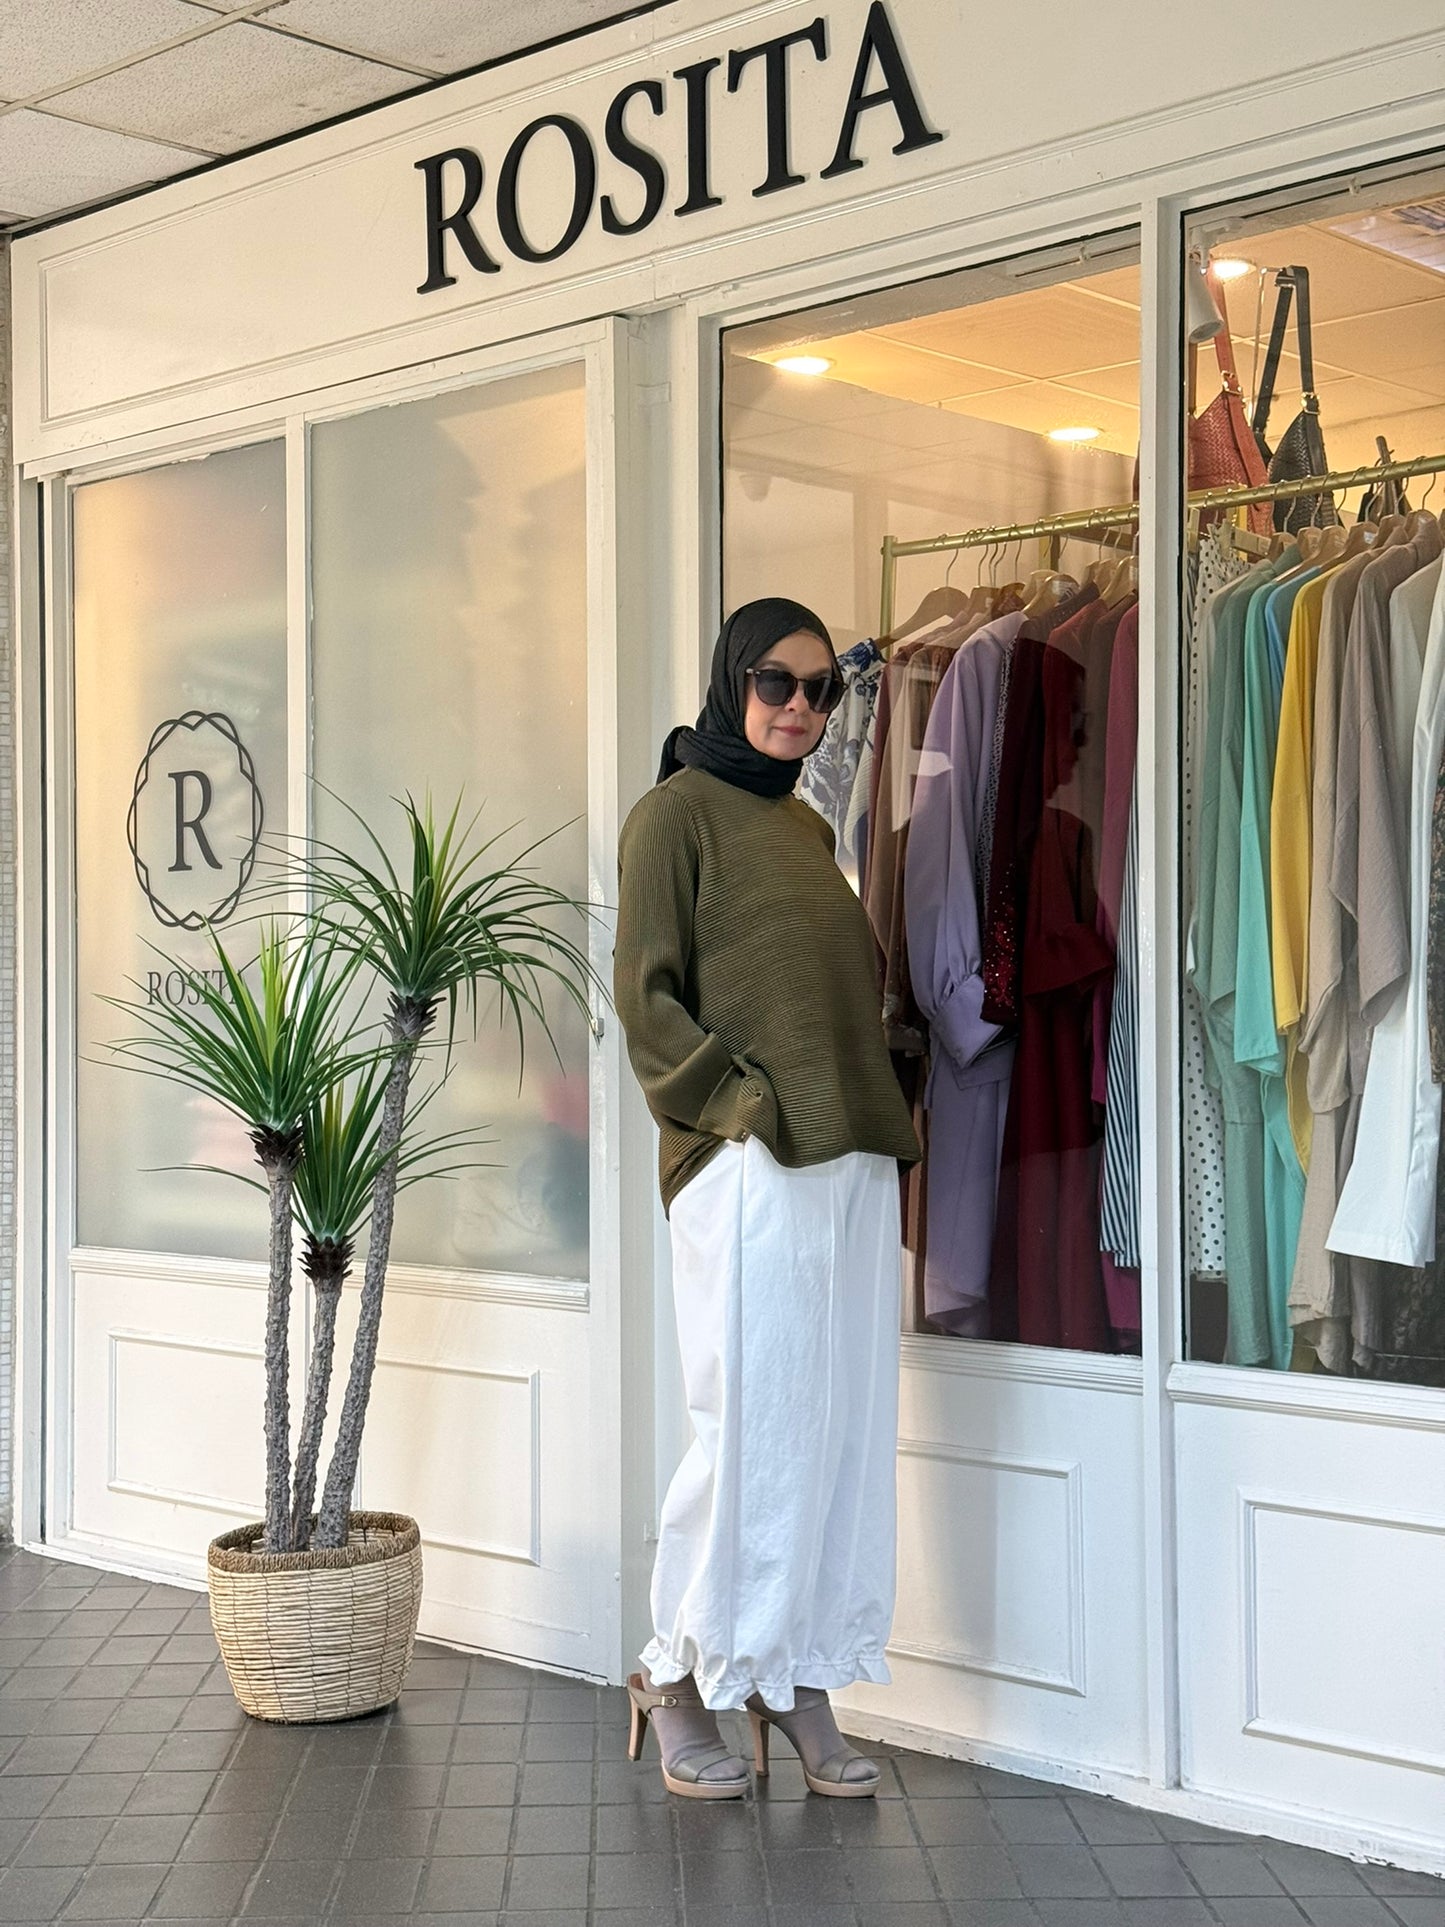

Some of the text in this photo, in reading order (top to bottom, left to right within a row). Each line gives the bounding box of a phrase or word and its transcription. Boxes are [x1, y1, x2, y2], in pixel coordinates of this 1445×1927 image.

[414, 0, 943, 295] ROSITA
[168, 770, 223, 872] R
[147, 970, 246, 1006] ROSIT
